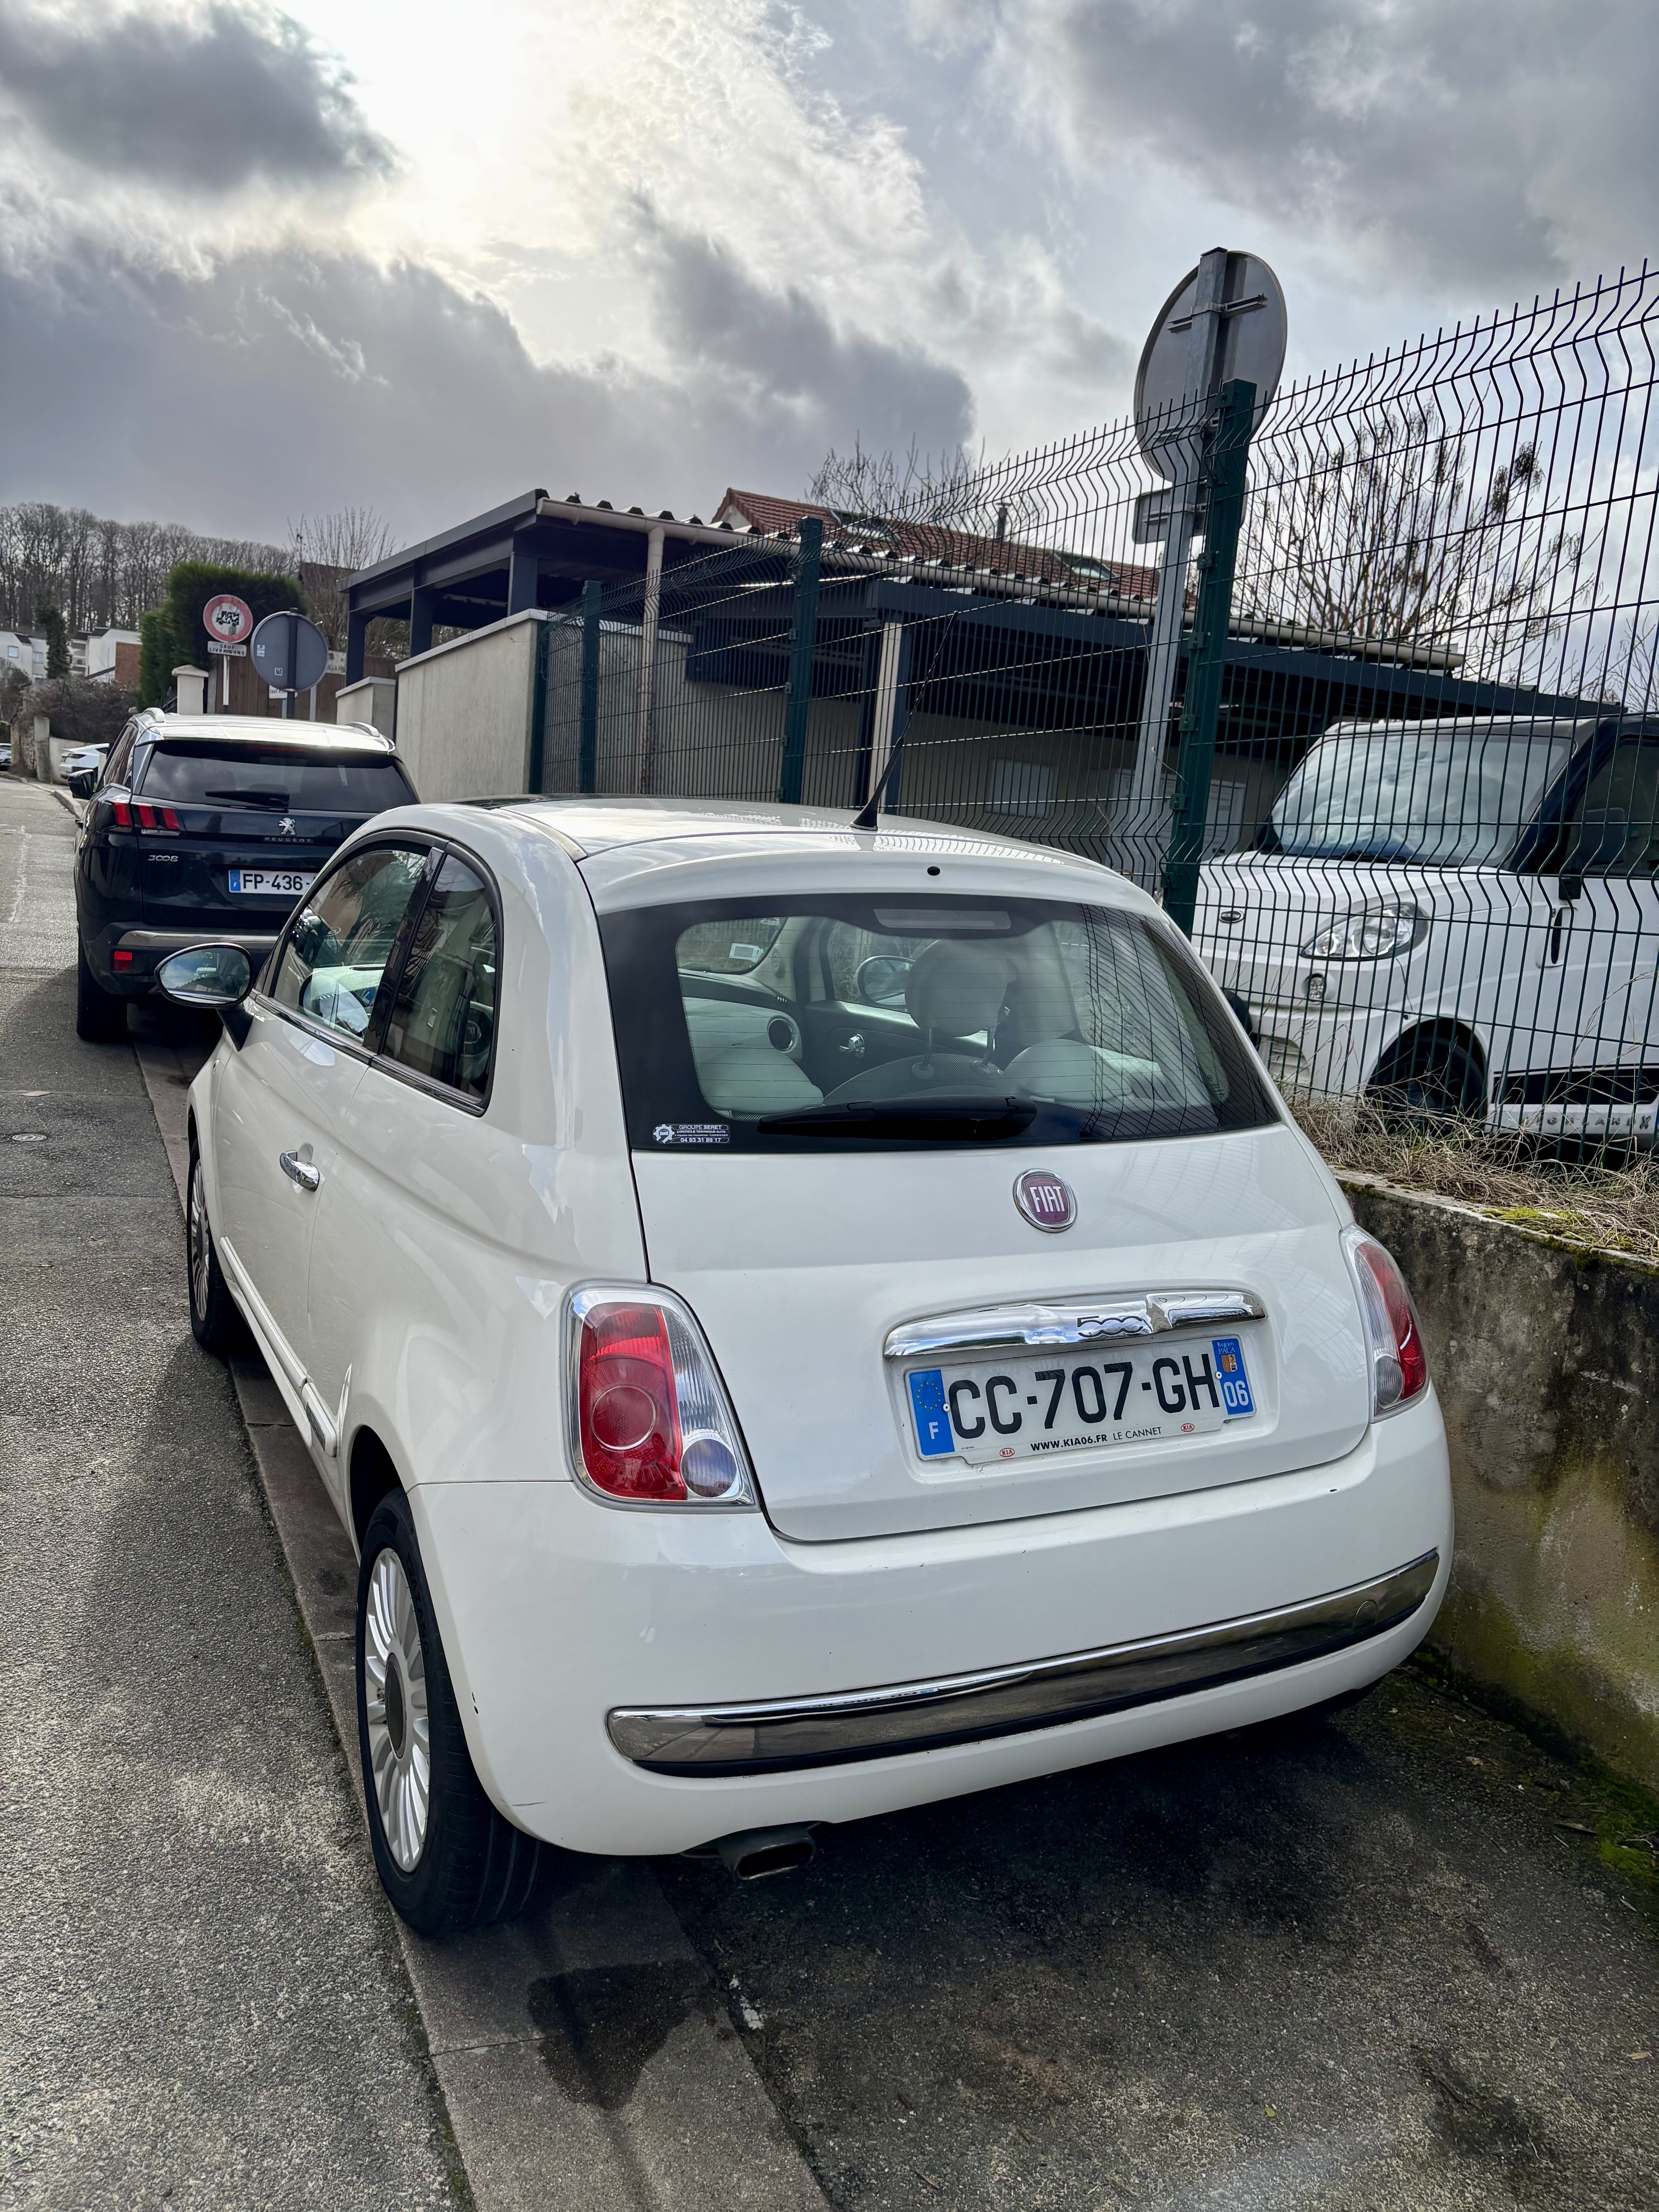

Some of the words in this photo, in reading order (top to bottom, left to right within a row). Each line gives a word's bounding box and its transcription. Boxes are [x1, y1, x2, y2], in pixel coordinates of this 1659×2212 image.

[243, 873, 316, 891] FP-436-
[1029, 1186, 1065, 1212] FIAT
[1077, 1316, 1144, 1338] 500
[948, 1353, 1220, 1439] CC-707-GH
[1223, 1381, 1249, 1407] 06
[929, 1422, 939, 1440] F
[1030, 1434, 1108, 1451] WWW.KIA06.FR
[1113, 1432, 1123, 1441] LE
[1125, 1427, 1162, 1439] CANNET
